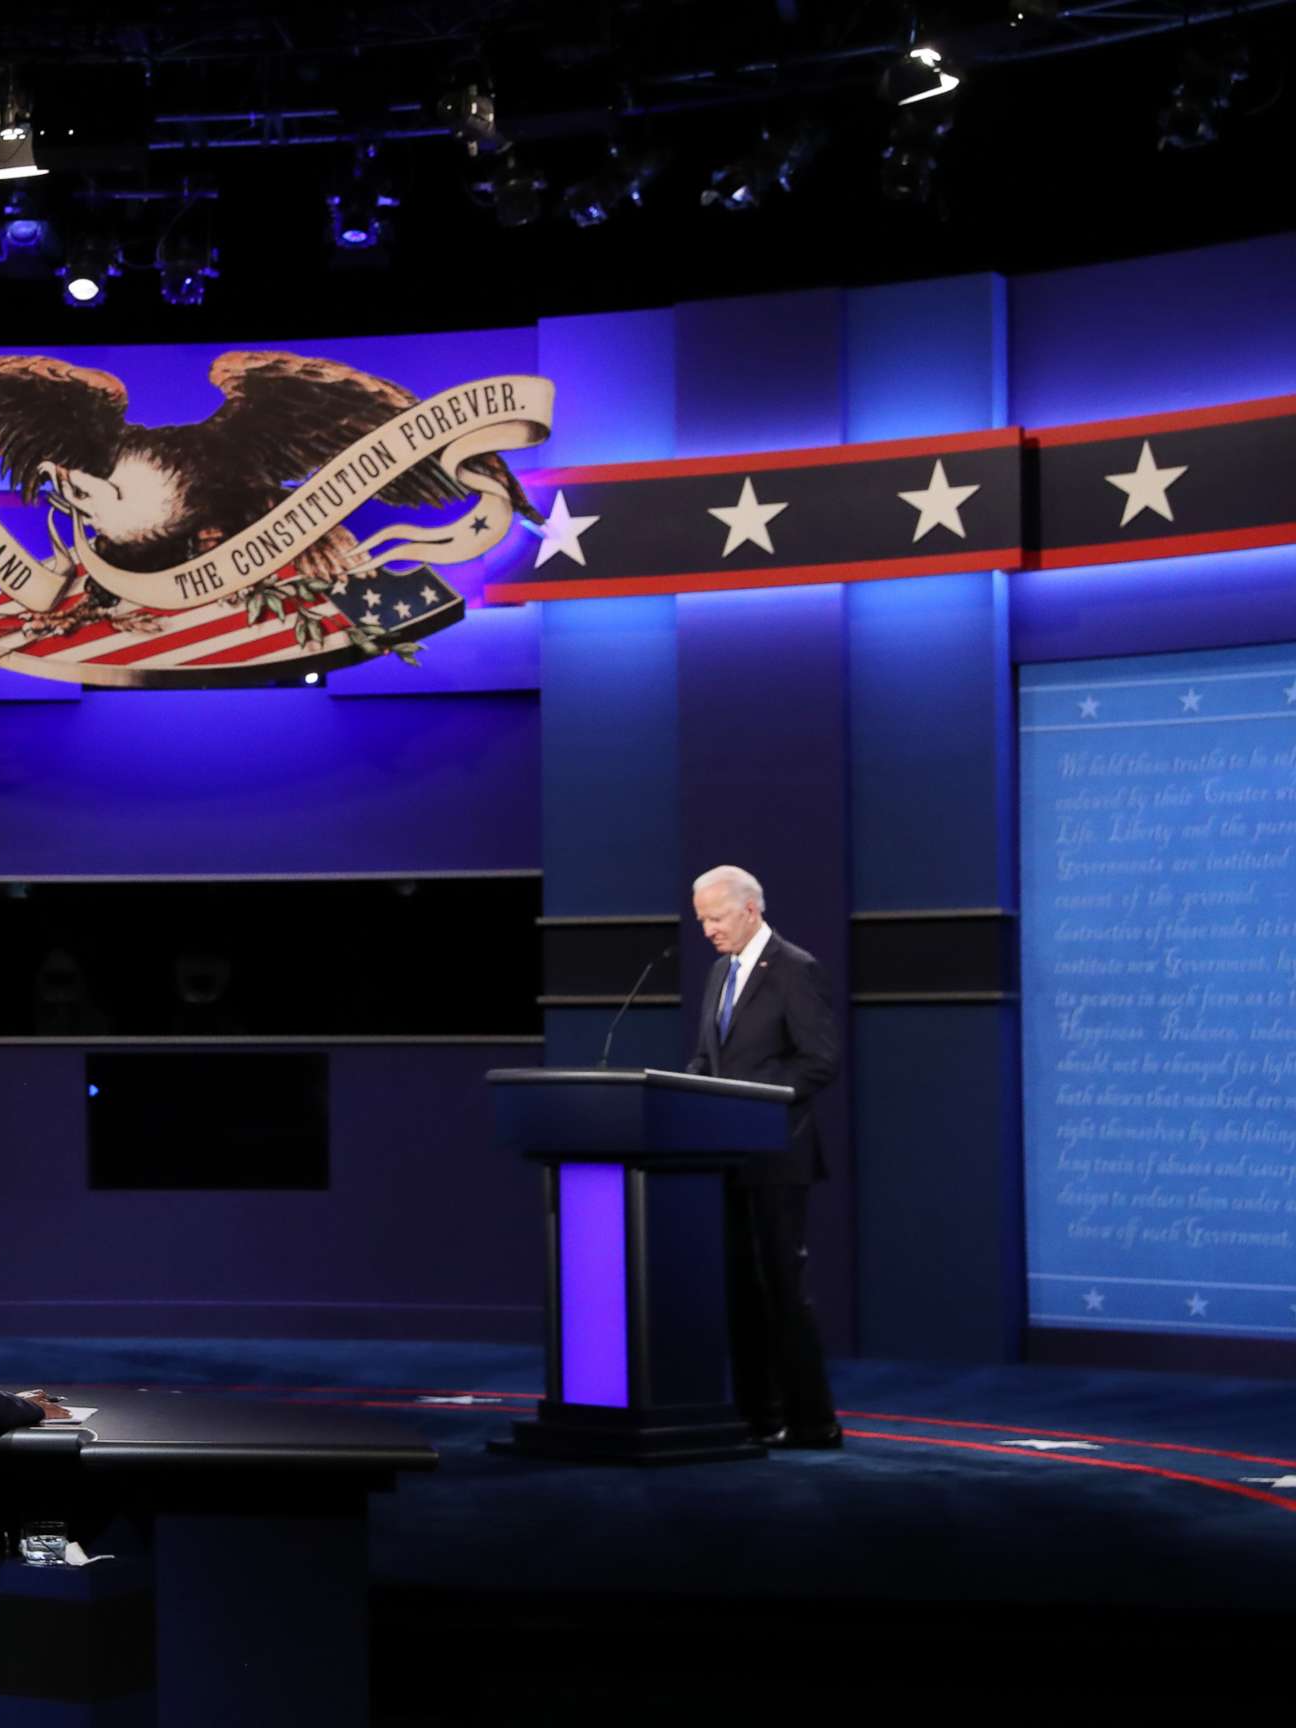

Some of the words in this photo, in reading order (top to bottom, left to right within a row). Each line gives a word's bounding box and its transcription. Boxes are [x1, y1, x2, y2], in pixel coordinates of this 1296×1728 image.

[174, 561, 224, 600] THE
[230, 439, 397, 576] CONSTITUTION
[399, 382, 526, 451] FOREVER.
